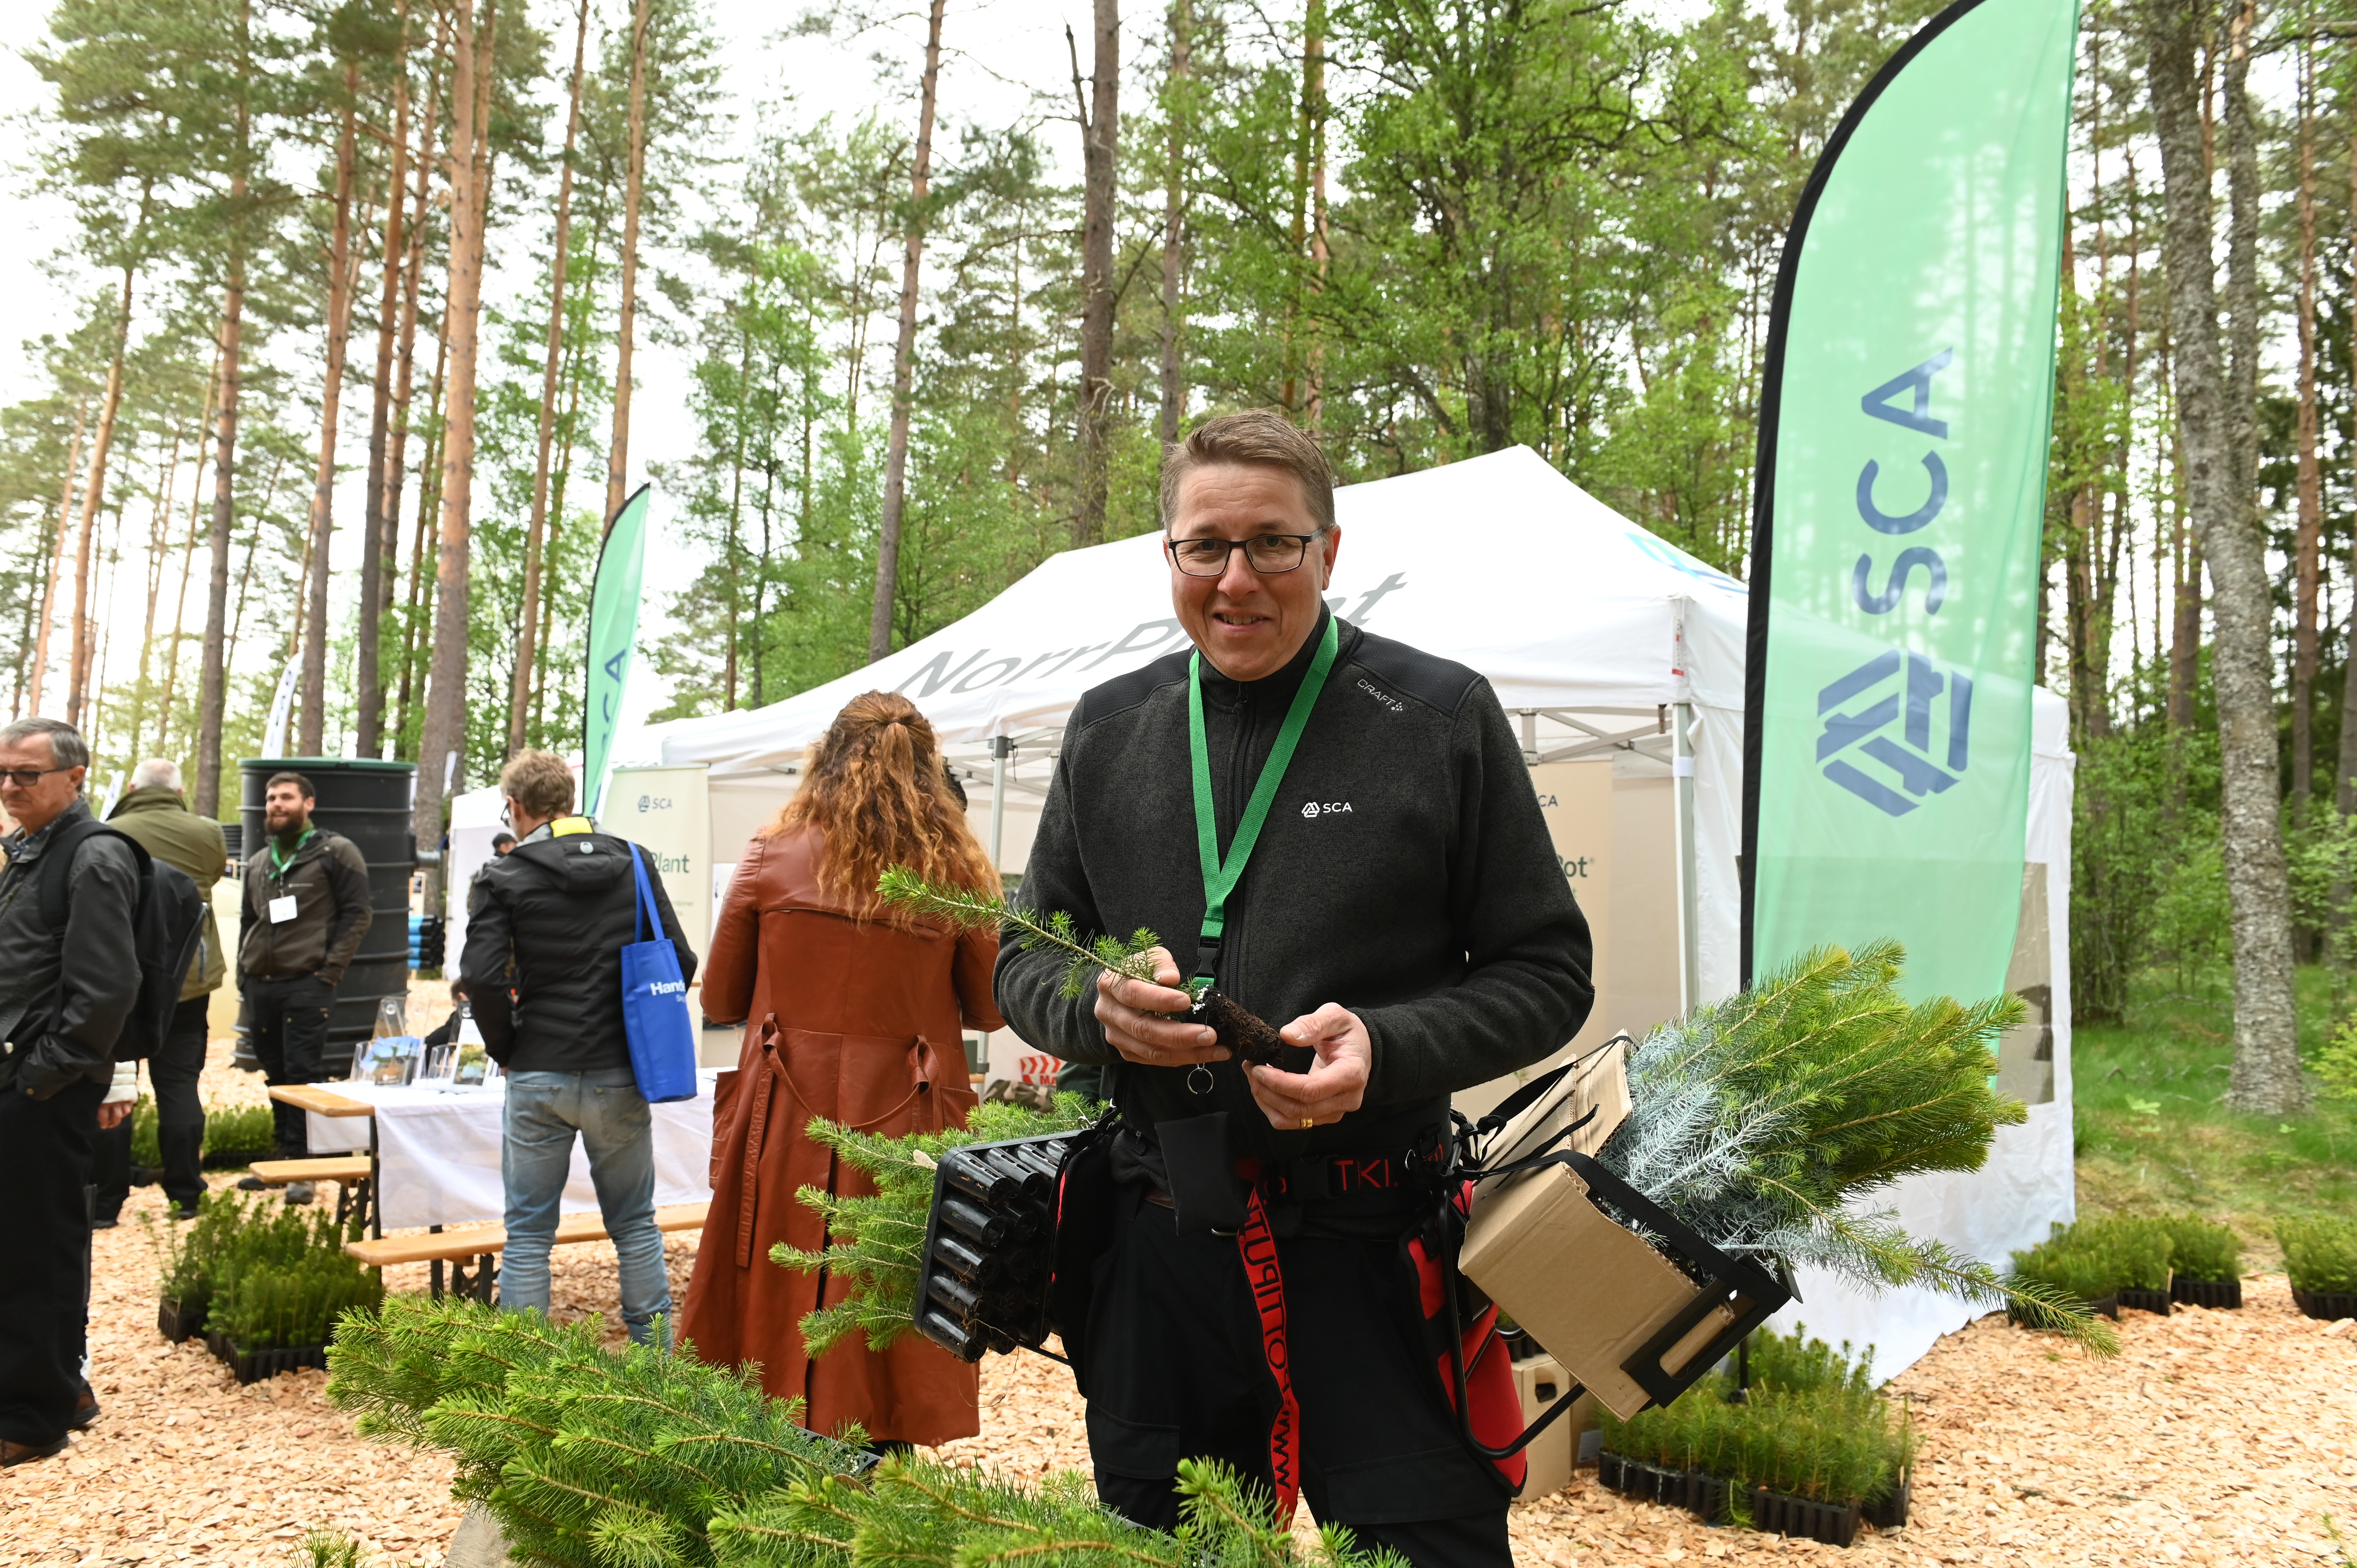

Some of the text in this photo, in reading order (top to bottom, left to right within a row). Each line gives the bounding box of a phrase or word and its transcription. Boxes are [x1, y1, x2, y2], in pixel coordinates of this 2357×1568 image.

[1852, 346, 1953, 616] SCA
[893, 571, 1409, 699] NorrPlt
[1357, 679, 1396, 705] CRAFT
[652, 798, 673, 809] SCA
[1323, 802, 1353, 813] SCA
[1538, 795, 1558, 807] CA
